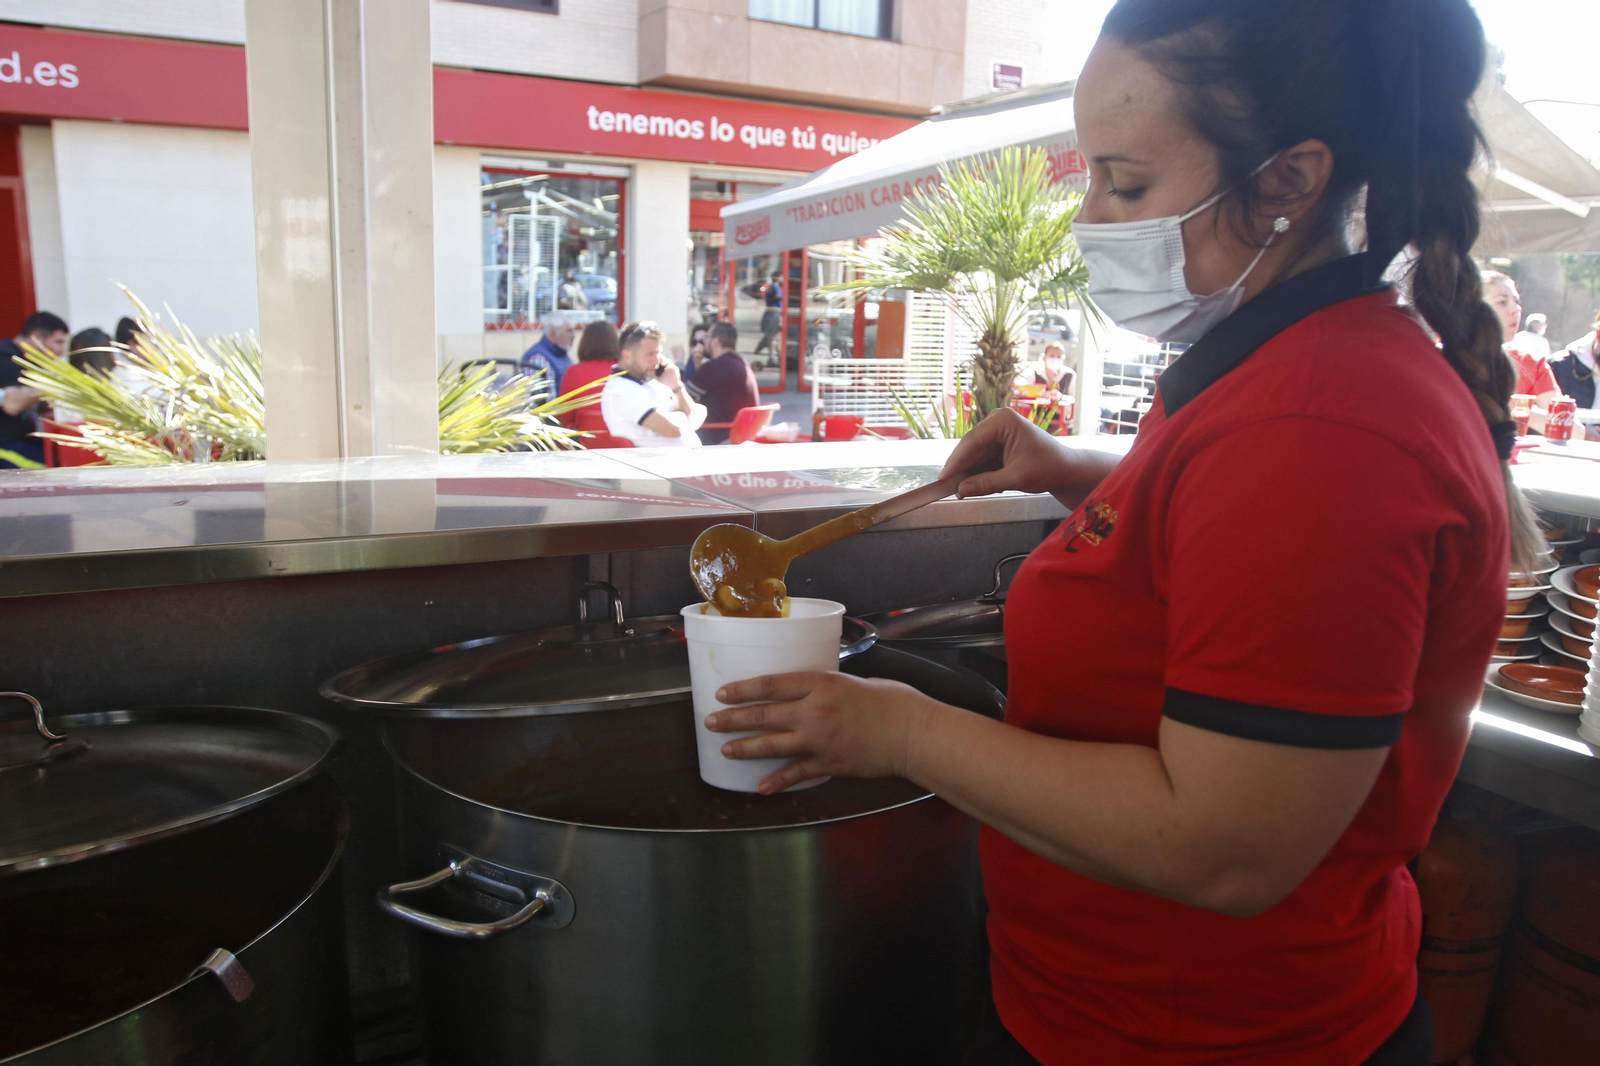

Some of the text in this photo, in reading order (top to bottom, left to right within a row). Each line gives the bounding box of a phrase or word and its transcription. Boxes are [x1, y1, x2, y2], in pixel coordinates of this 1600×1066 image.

[586, 105, 887, 157] tenemos lo que tú quier
